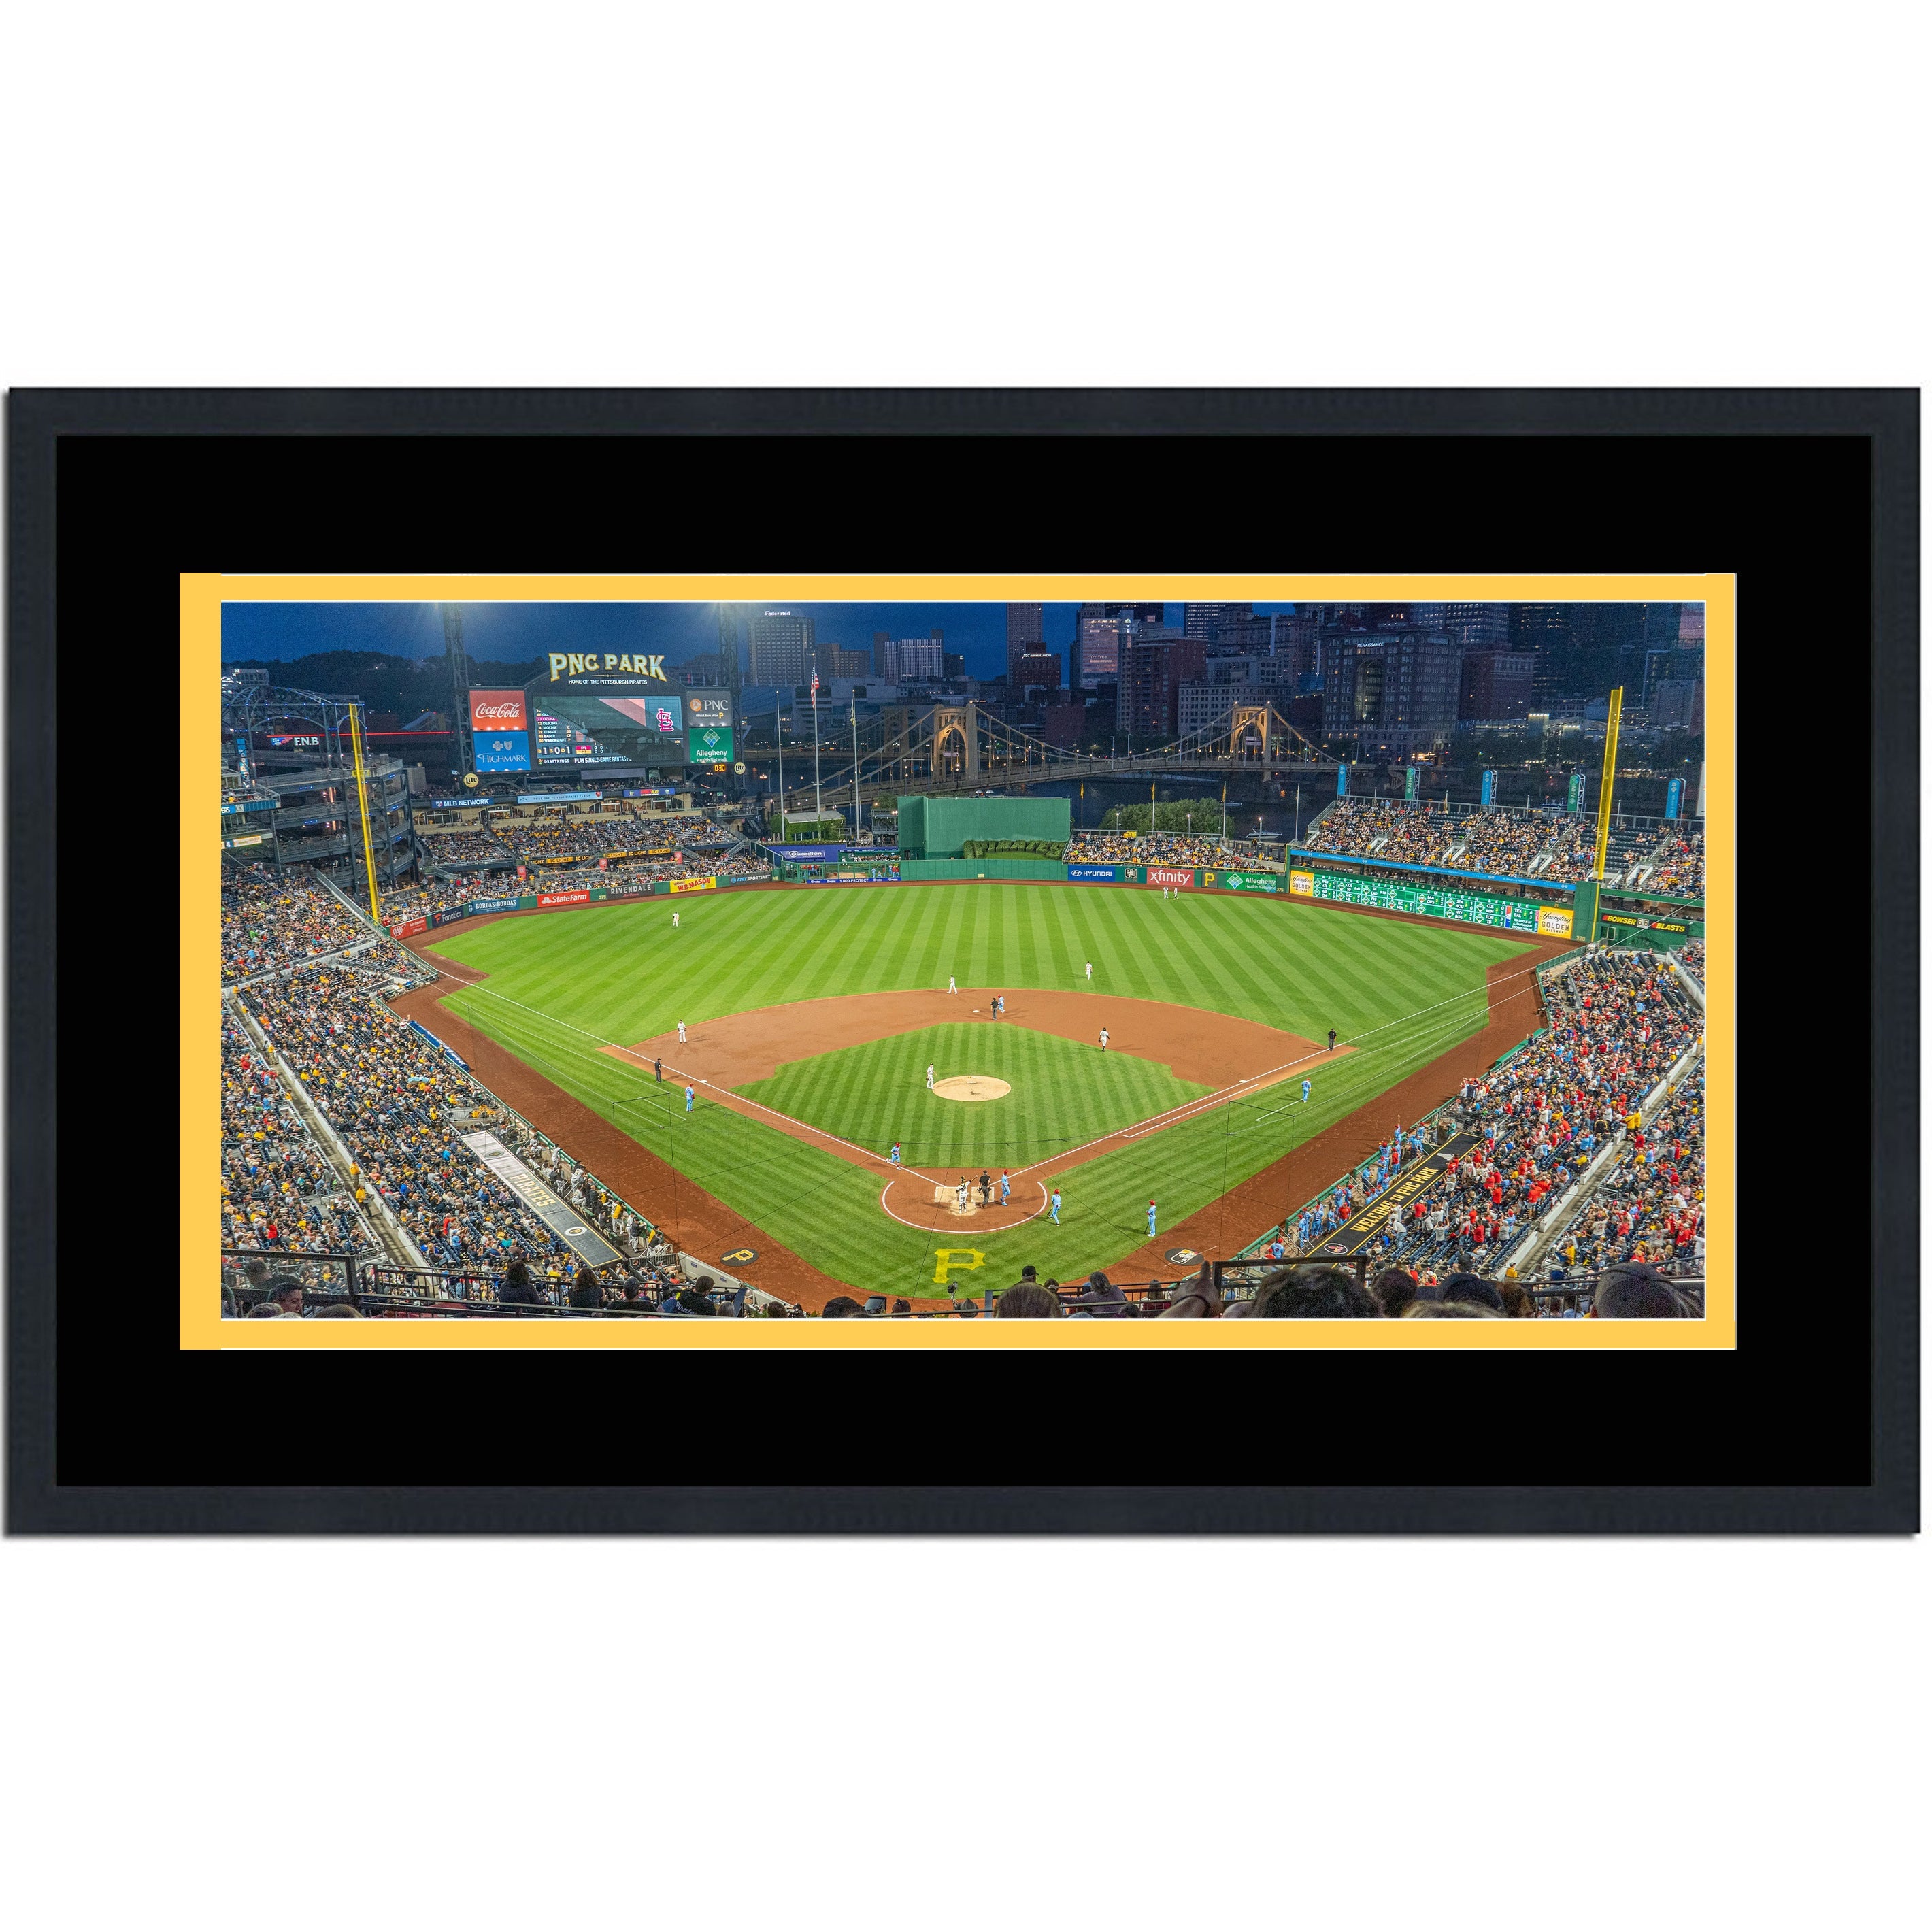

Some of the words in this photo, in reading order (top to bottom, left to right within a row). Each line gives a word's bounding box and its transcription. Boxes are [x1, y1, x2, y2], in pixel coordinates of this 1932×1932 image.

[548, 653, 600, 682] PNC
[604, 654, 667, 682] PARK
[475, 703, 521, 718] Coca-Cola
[703, 699, 729, 710] PNC
[294, 737, 320, 746] F.N.B
[477, 753, 527, 763] HIGHMARK
[696, 750, 728, 758] Allegheny
[689, 878, 710, 888] MASON
[1150, 870, 1190, 886] xfinity
[1205, 873, 1215, 887] P
[1245, 878, 1276, 886] Allegheny
[1322, 876, 1365, 884] NATIONAL
[1373, 882, 1406, 890] LEAGUE
[1373, 878, 1410, 887] WELCOME
[611, 884, 652, 895] RIVENDALE
[1427, 890, 1479, 901] AMERICAN
[1488, 899, 1529, 908] LEAGUE
[442, 910, 462, 922] Fanatics
[1542, 911, 1571, 922] Yuengling
[1542, 921, 1569, 931] GOLDEN
[1607, 916, 1637, 925] BOWSER
[1656, 922, 1686, 932] BLASTS
[1411, 1167, 1439, 1184] PARK
[510, 1173, 556, 1207] PIRATES
[1396, 1182, 1418, 1196] PNC
[1390, 1193, 1404, 1202] TO
[1350, 1201, 1395, 1232] WELCOME
[722, 1249, 754, 1261] P
[932, 1248, 986, 1284] P
